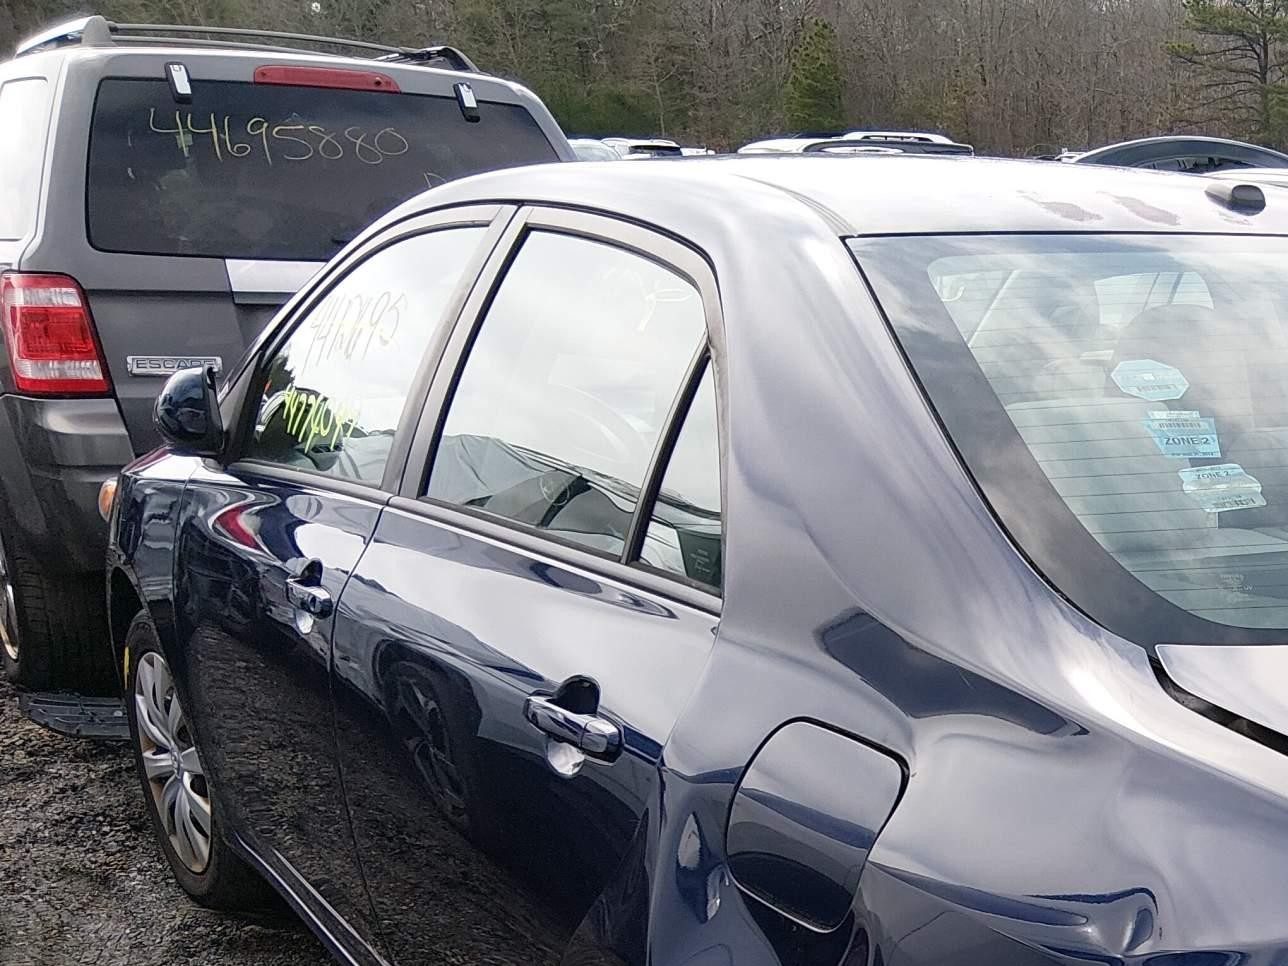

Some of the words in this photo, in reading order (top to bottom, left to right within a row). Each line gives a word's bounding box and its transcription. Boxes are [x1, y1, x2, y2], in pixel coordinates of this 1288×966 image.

[150, 107, 408, 166] 44695880
[1165, 436, 1199, 446] ZONE
[1202, 436, 1210, 445] 2
